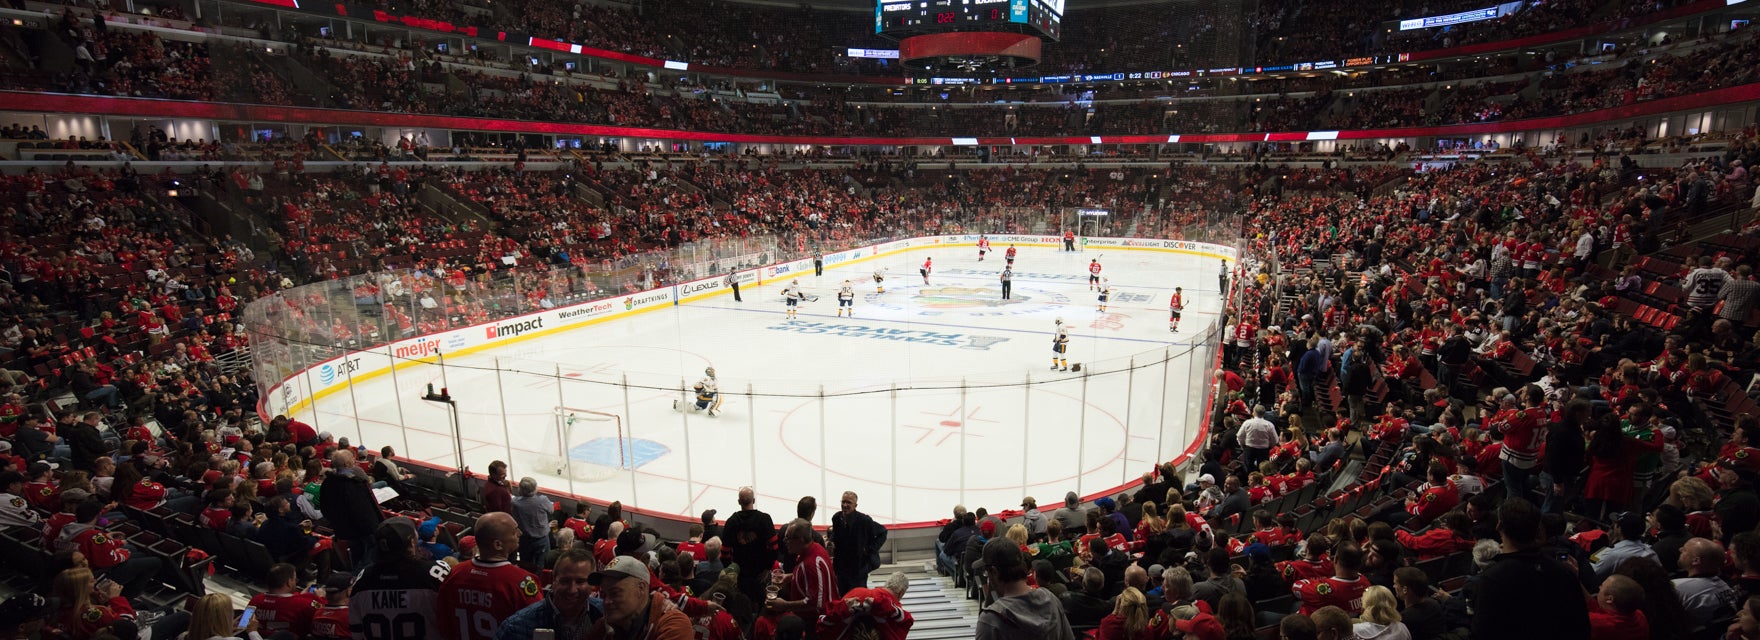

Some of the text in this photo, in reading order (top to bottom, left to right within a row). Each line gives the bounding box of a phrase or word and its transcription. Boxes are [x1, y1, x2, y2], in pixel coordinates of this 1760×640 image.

[884, 3, 912, 12] PREDATORS
[1163, 241, 1196, 250] DISCOVER
[691, 280, 719, 293] LEXUS
[1696, 278, 1721, 295] 35
[633, 293, 668, 307] DRAFTKINGS
[558, 302, 613, 320] WeatherTech
[497, 316, 543, 337] impact
[1333, 315, 1345, 325] 50
[1239, 329, 1247, 339] 2
[395, 338, 441, 359] meijer
[337, 358, 361, 377] AT&T
[372, 591, 407, 609] KANE
[458, 588, 493, 608] TOEWS
[454, 608, 499, 640] 19
